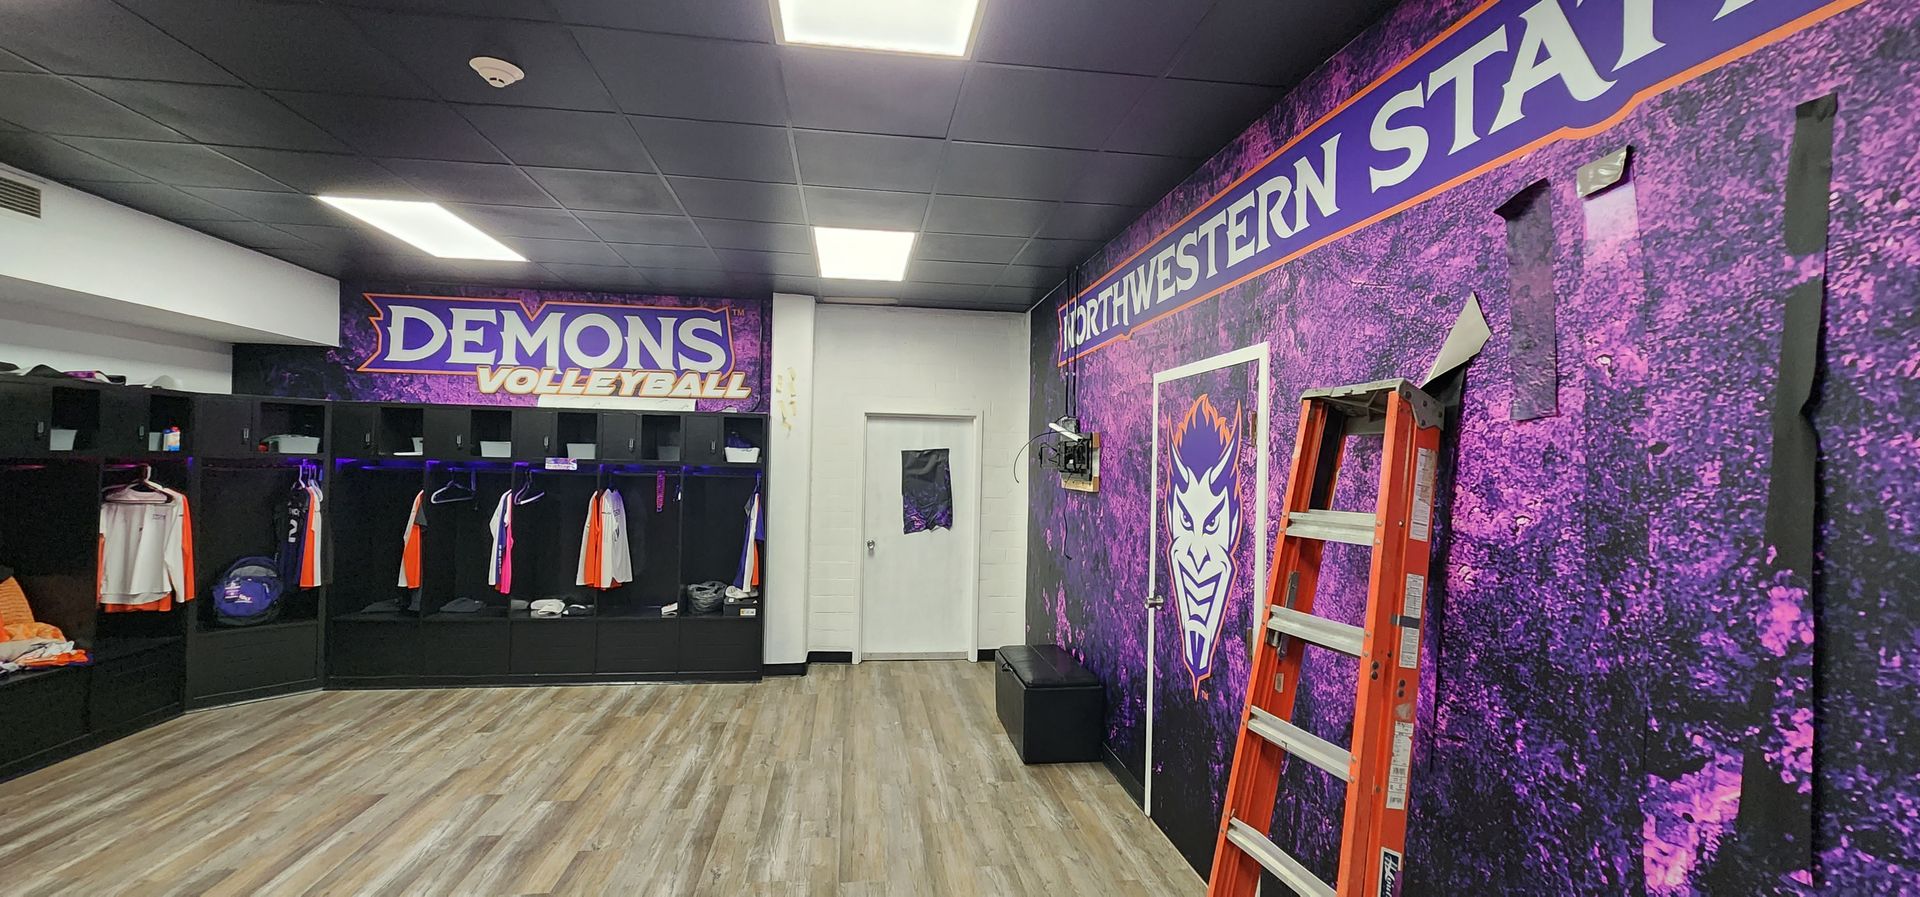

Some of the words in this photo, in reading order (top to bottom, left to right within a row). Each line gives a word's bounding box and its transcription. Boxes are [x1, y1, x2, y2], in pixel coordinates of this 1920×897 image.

[1063, 134, 1341, 353] NORTHWESTERN
[1369, 0, 1754, 194] STA
[732, 308, 745, 316] TM
[383, 304, 728, 374] DEMONS
[477, 366, 752, 398] VOLLEYBALL
